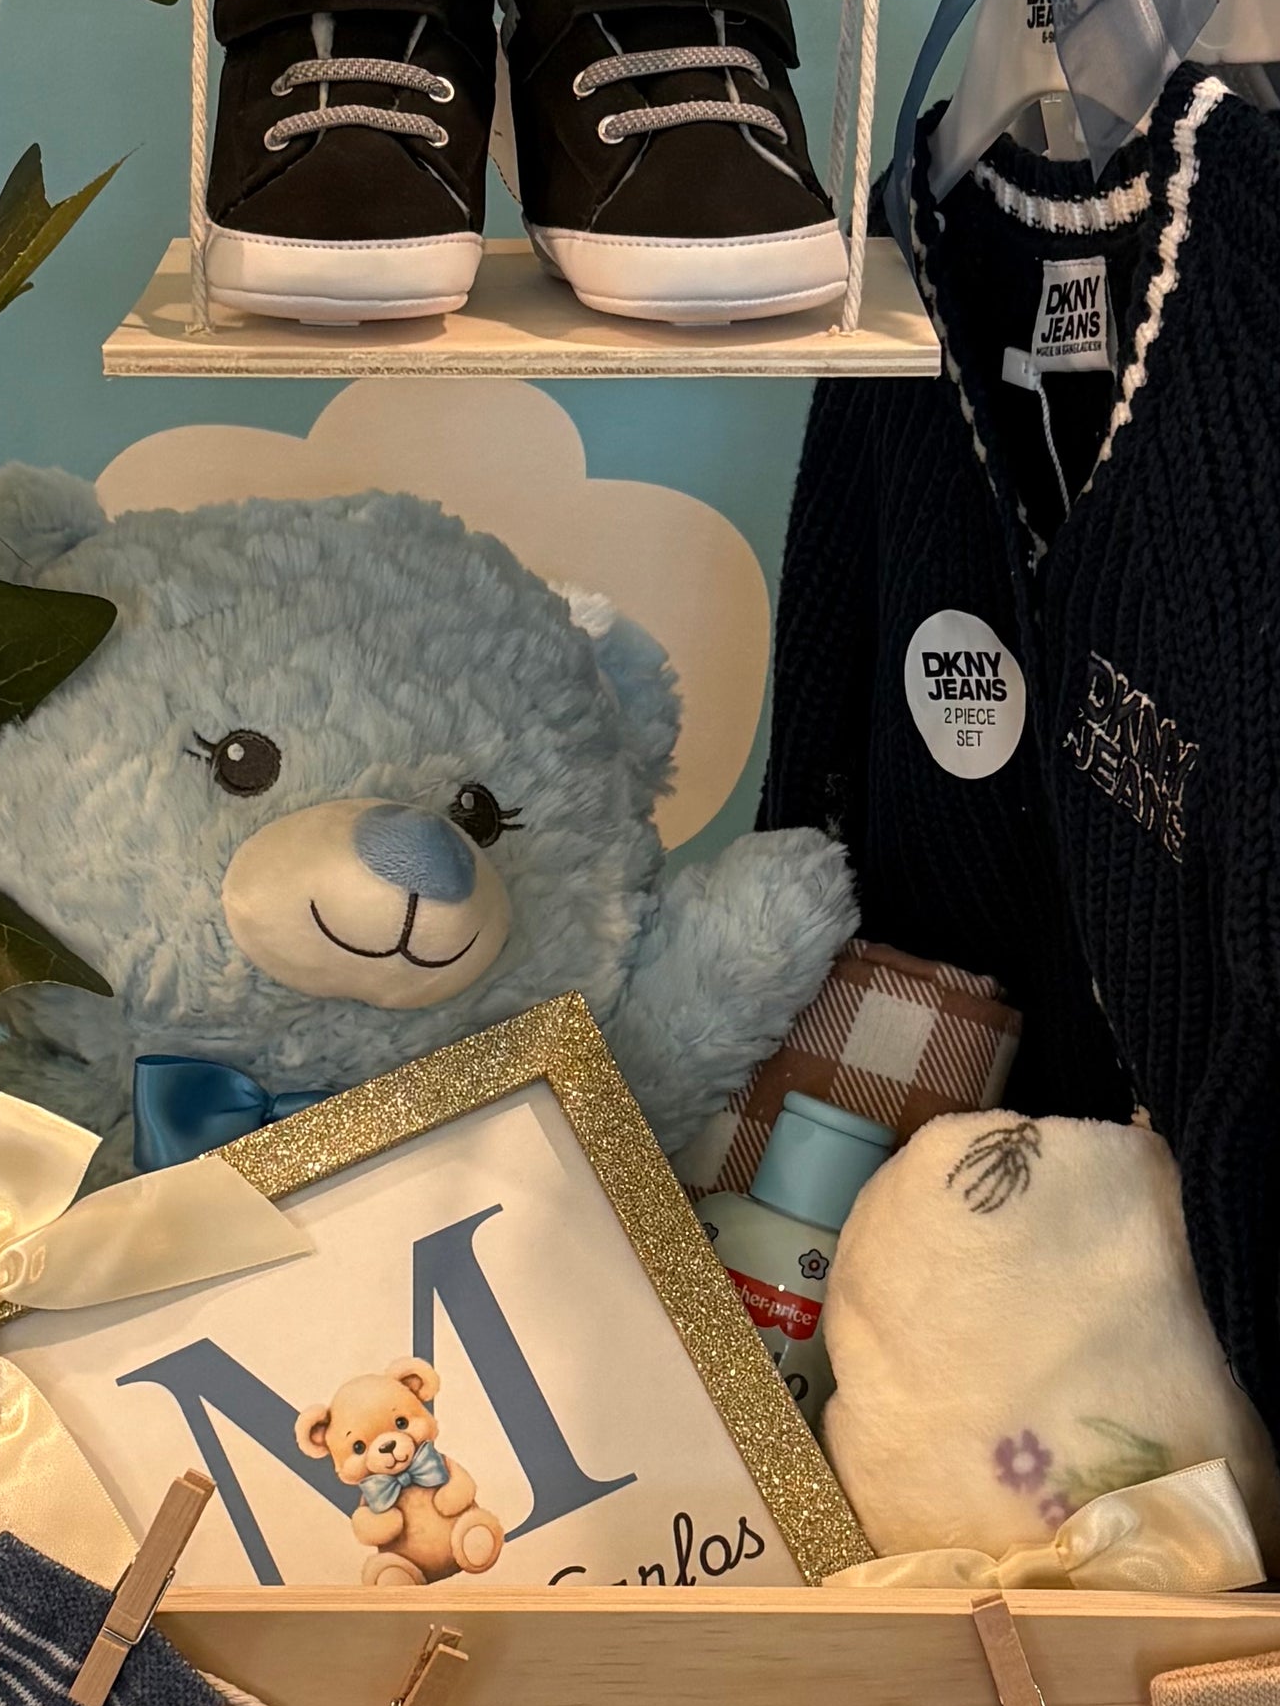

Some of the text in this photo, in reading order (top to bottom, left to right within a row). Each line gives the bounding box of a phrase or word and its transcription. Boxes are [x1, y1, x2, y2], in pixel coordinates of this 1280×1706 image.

[1045, 275, 1101, 315] DKNY
[1040, 310, 1101, 344] JEANS
[922, 651, 1001, 678] DKNY
[928, 679, 1008, 702] JEANS
[944, 707, 996, 726] 2 PIECE
[956, 730, 983, 747] SET
[734, 1284, 813, 1326] her-price
[116, 1203, 638, 1585] M
